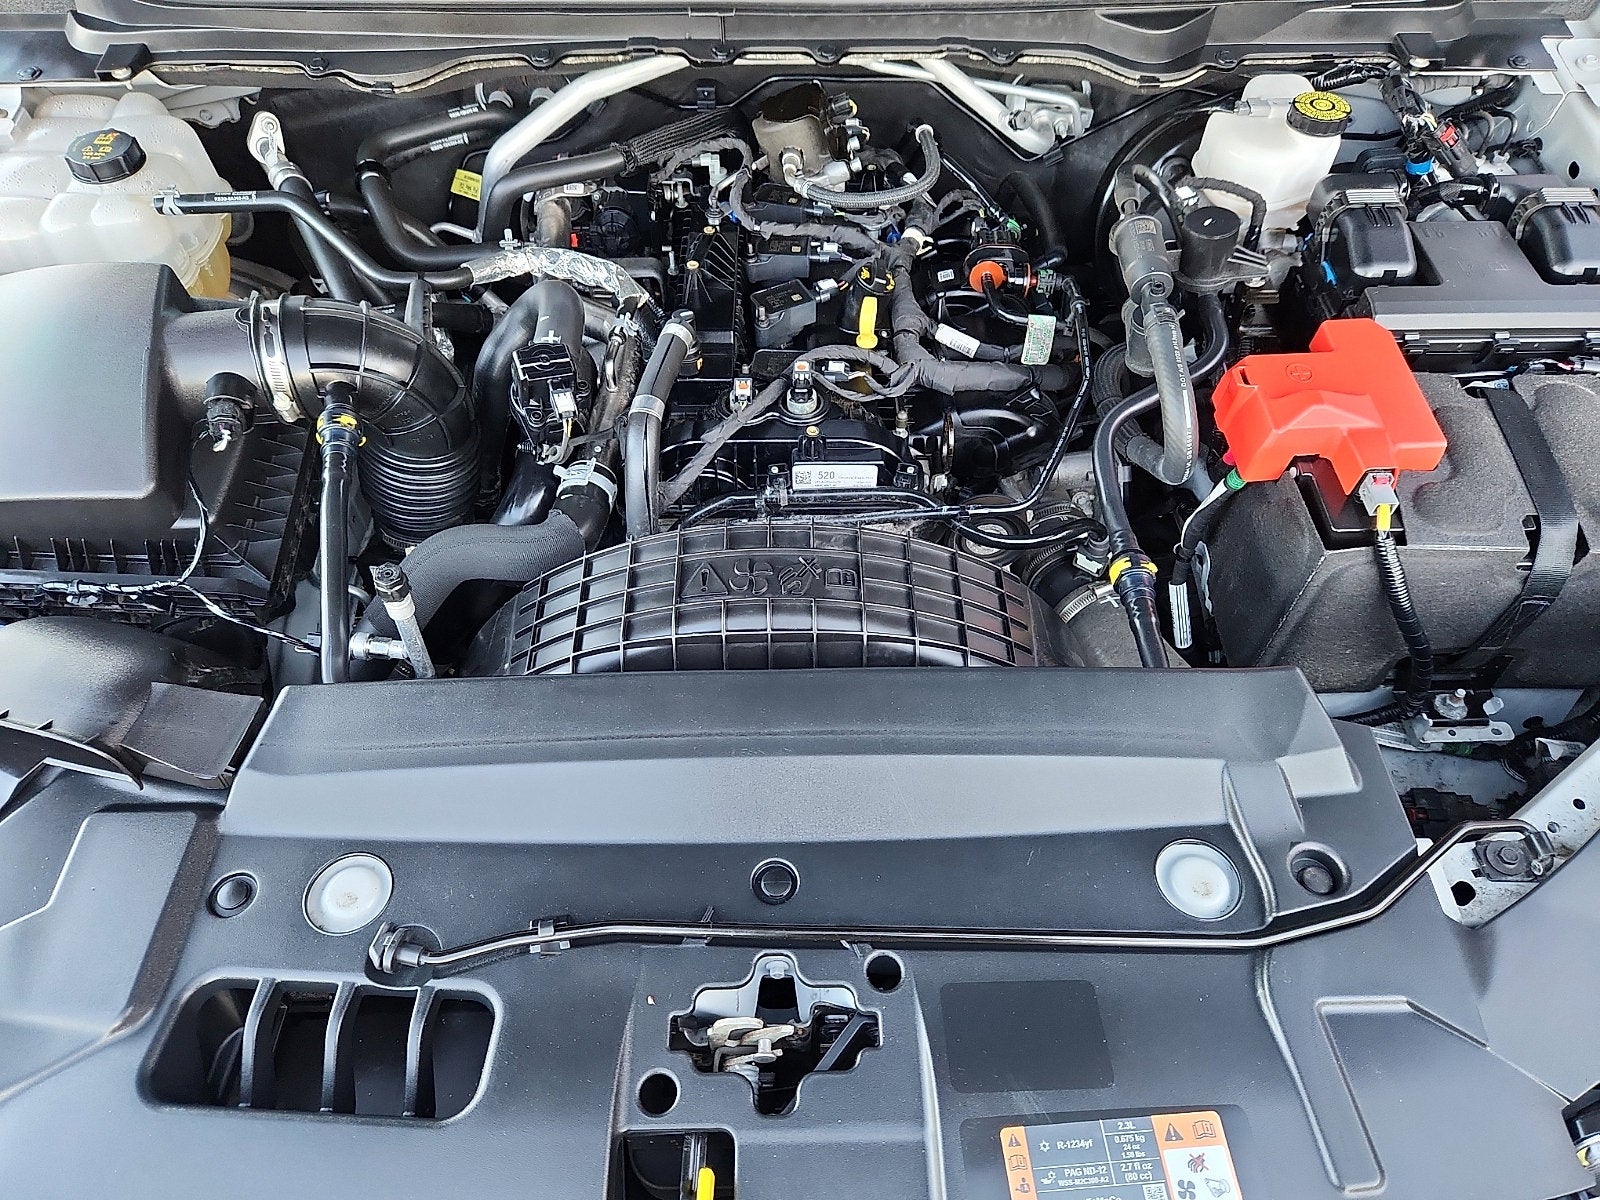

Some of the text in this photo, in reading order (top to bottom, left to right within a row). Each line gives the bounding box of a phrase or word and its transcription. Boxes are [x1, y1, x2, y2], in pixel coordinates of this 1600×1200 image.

[818, 471, 835, 479] 520
[1117, 1121, 1136, 1130] 2.3L
[1114, 1134, 1145, 1143] 0.675 kg
[1057, 1139, 1093, 1149] R-1234yf
[1064, 1165, 1107, 1177] PAG ND-12
[1120, 1163, 1132, 1171] 2.7
[1133, 1162, 1141, 1170] fl
[1125, 1171, 1152, 1182] (80 cc)
